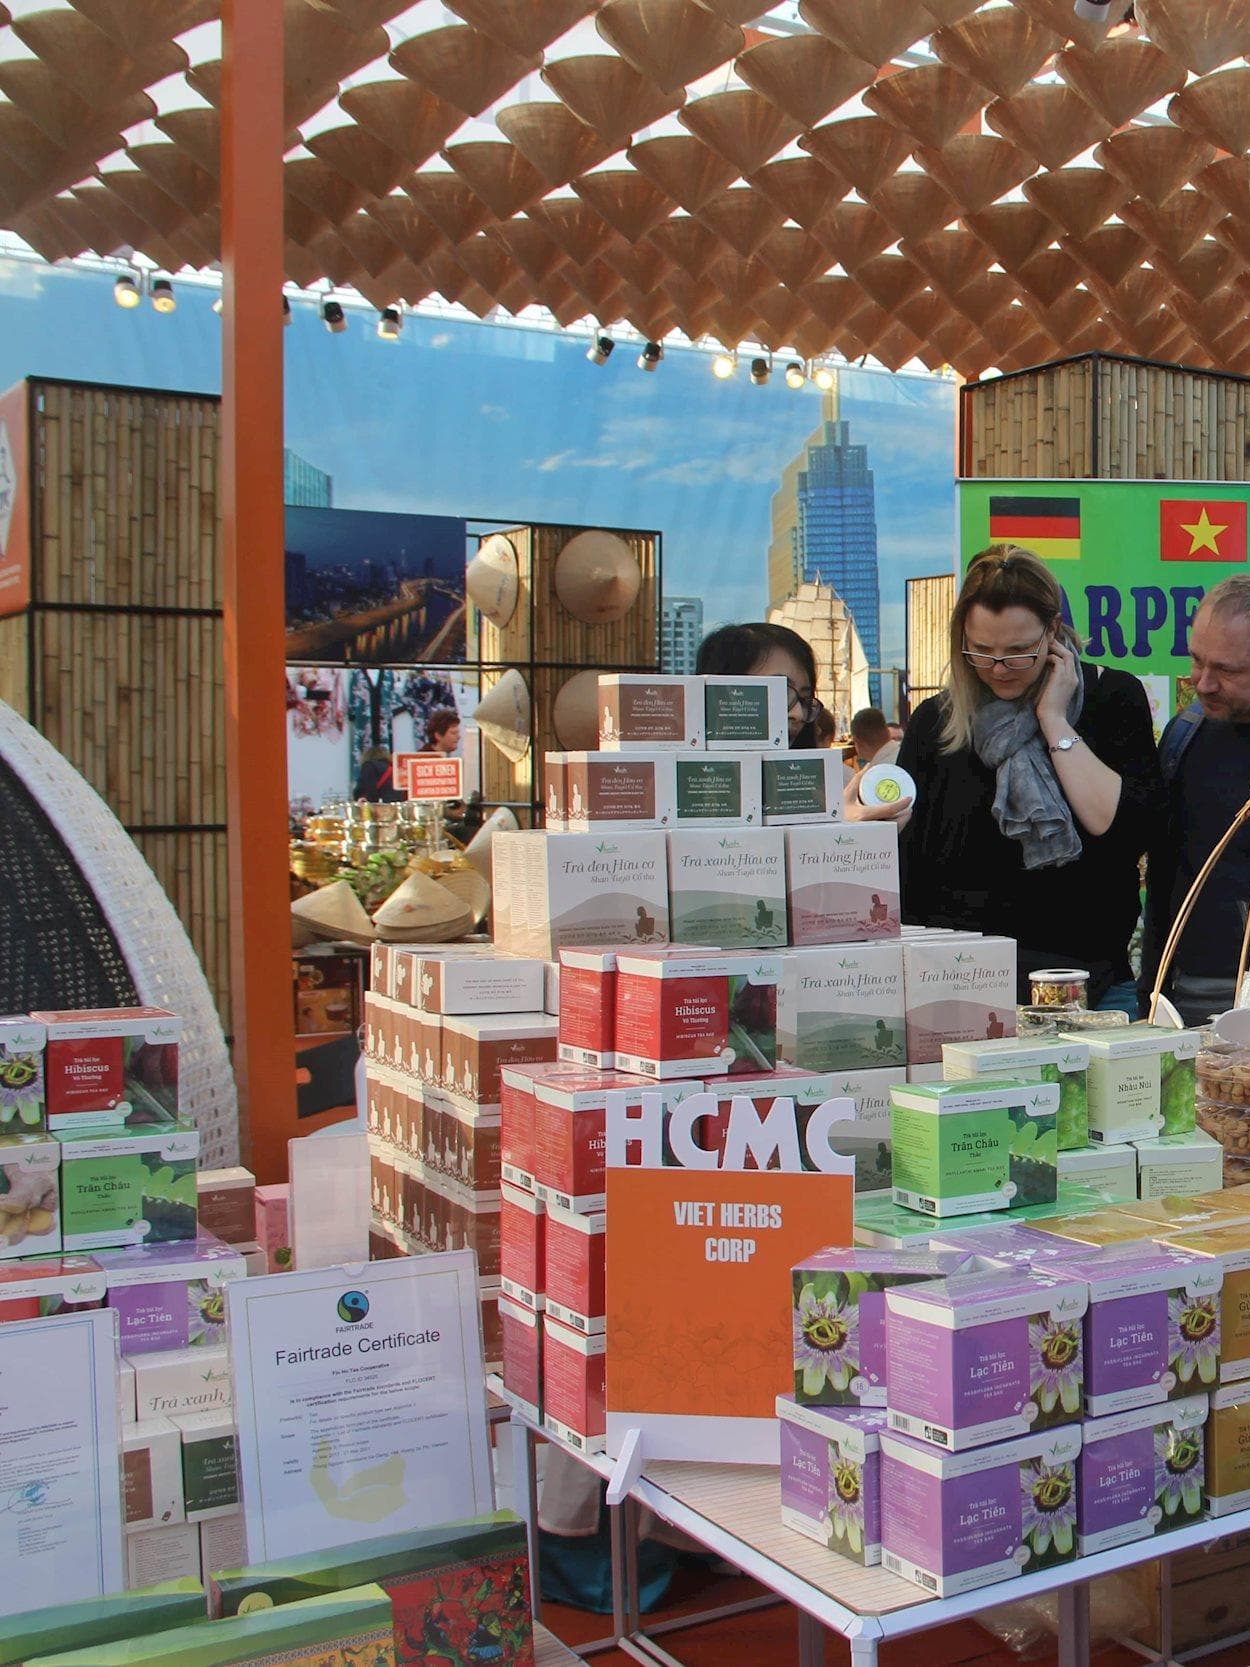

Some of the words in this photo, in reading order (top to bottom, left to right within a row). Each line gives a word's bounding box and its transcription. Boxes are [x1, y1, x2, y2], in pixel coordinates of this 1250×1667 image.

[704, 854, 736, 868] xanh
[825, 975, 853, 988] xanh
[675, 1005, 716, 1016] Hibiscus
[64, 1063, 109, 1074] Hibiscus
[606, 1092, 856, 1173] HCMC
[951, 1140, 973, 1152] Trân
[975, 1139, 999, 1149] Châu
[76, 1183, 101, 1194] Trân
[103, 1181, 130, 1191] Châu
[674, 1201, 715, 1227] VIET
[720, 1202, 783, 1229] HERBS
[705, 1238, 756, 1263] CORP
[127, 1315, 145, 1326] Lạc
[149, 1312, 172, 1322] Tiên
[335, 1322, 373, 1334] FAIRTRADE
[275, 1342, 353, 1366] Fairtrade
[358, 1329, 440, 1354] Certificate
[1110, 1335, 1129, 1349] Lạc
[1131, 1330, 1153, 1344] Tiên
[970, 1365, 989, 1379] Lạc
[992, 1360, 1015, 1374] Tiên
[150, 1395, 177, 1411] Trà
[182, 1388, 225, 1406] xanh
[1099, 1475, 1117, 1488] Lạc
[1120, 1469, 1141, 1482] Tiên
[960, 1513, 979, 1526] Lạc
[982, 1507, 1006, 1520] Tiên
